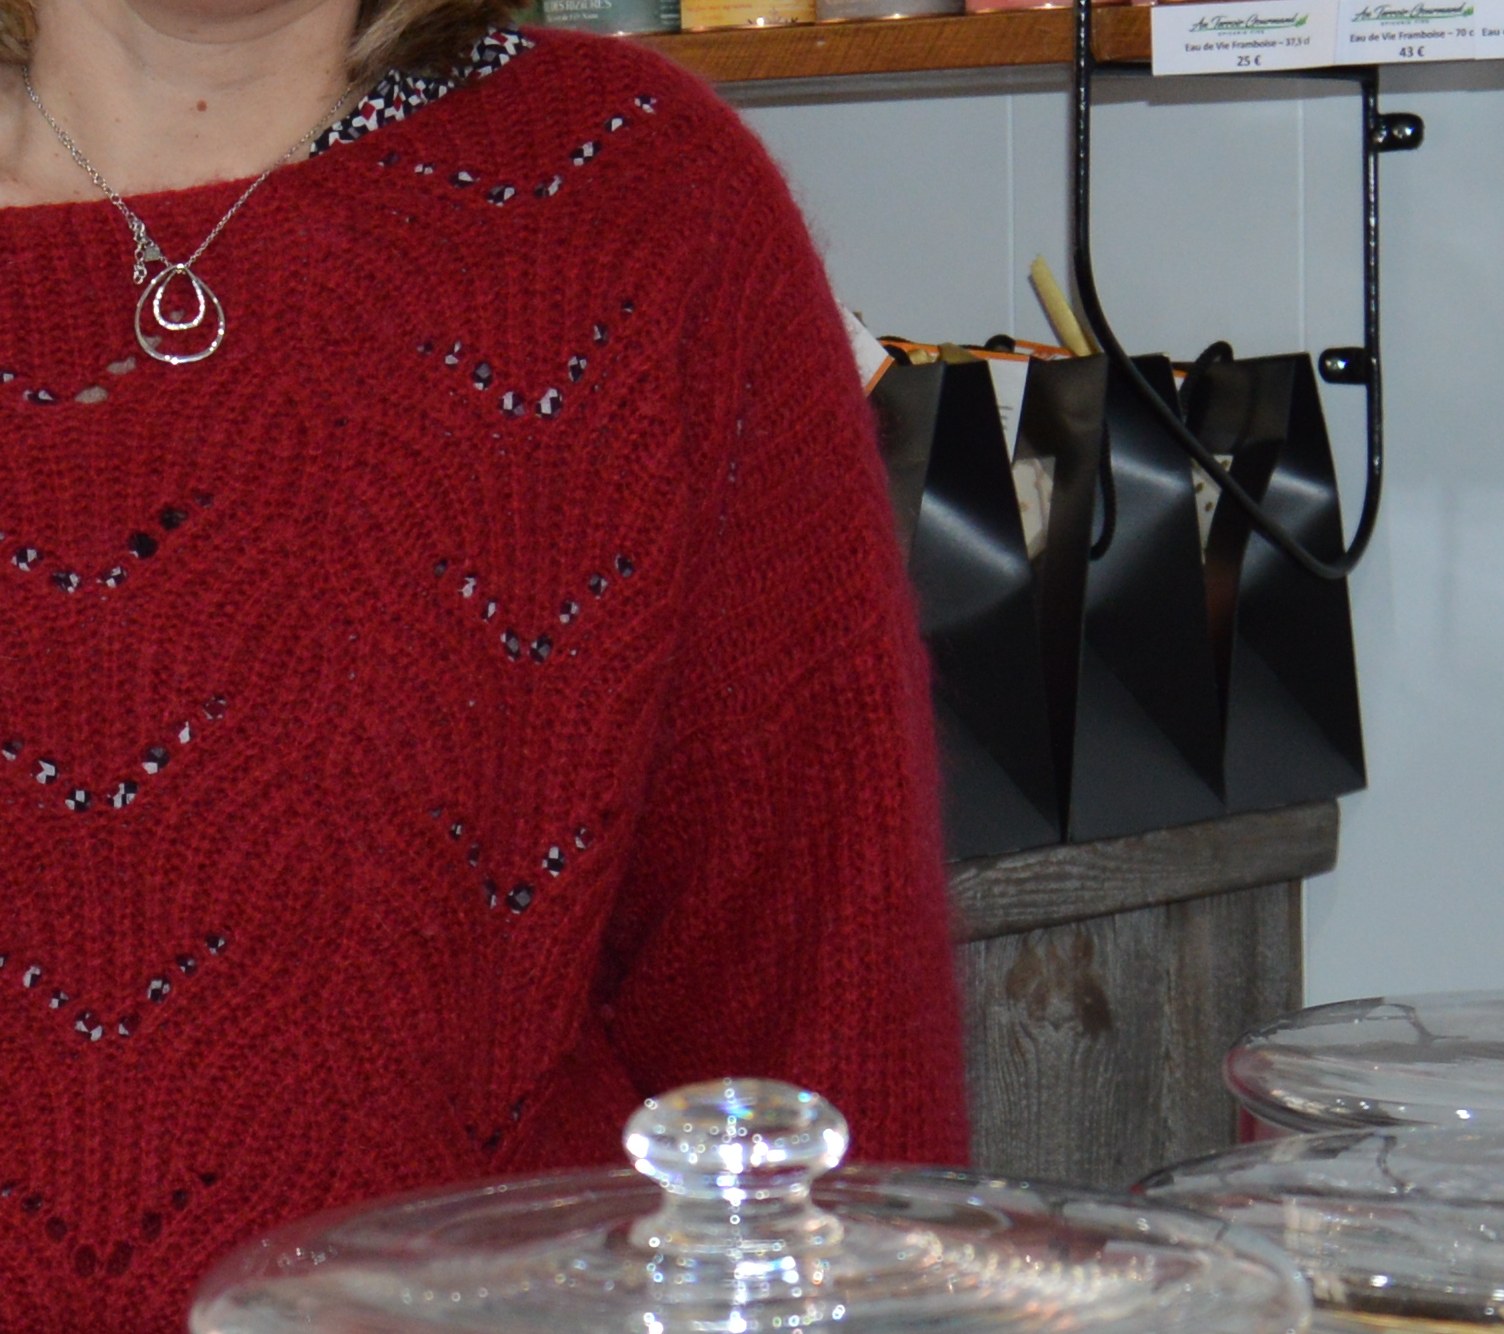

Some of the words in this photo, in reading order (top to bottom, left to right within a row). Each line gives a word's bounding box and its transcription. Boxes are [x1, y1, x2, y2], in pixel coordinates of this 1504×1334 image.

[1352, 7, 1374, 22] Au
[1374, 5, 1409, 19] Terroir
[1409, 2, 1467, 19] Gourmand
[1189, 17, 1210, 32] Au
[1210, 15, 1244, 29] Terroir
[1245, 13, 1297, 31] Gourmand
[1350, 34, 1367, 43] Eau
[1369, 33, 1380, 42] de
[1382, 32, 1396, 42] Vie
[1398, 30, 1445, 40] Framboise
[1456, 28, 1467, 37] 70
[1482, 28, 1501, 37] Eau
[1185, 43, 1202, 52] Eau
[1203, 42, 1214, 52] de
[1216, 42, 1230, 51] Vie
[1231, 40, 1277, 50] Framboise
[1399, 47, 1414, 57] 43
[1416, 46, 1425, 57] €
[1237, 56, 1252, 67] 25
[1253, 55, 1262, 66] €
